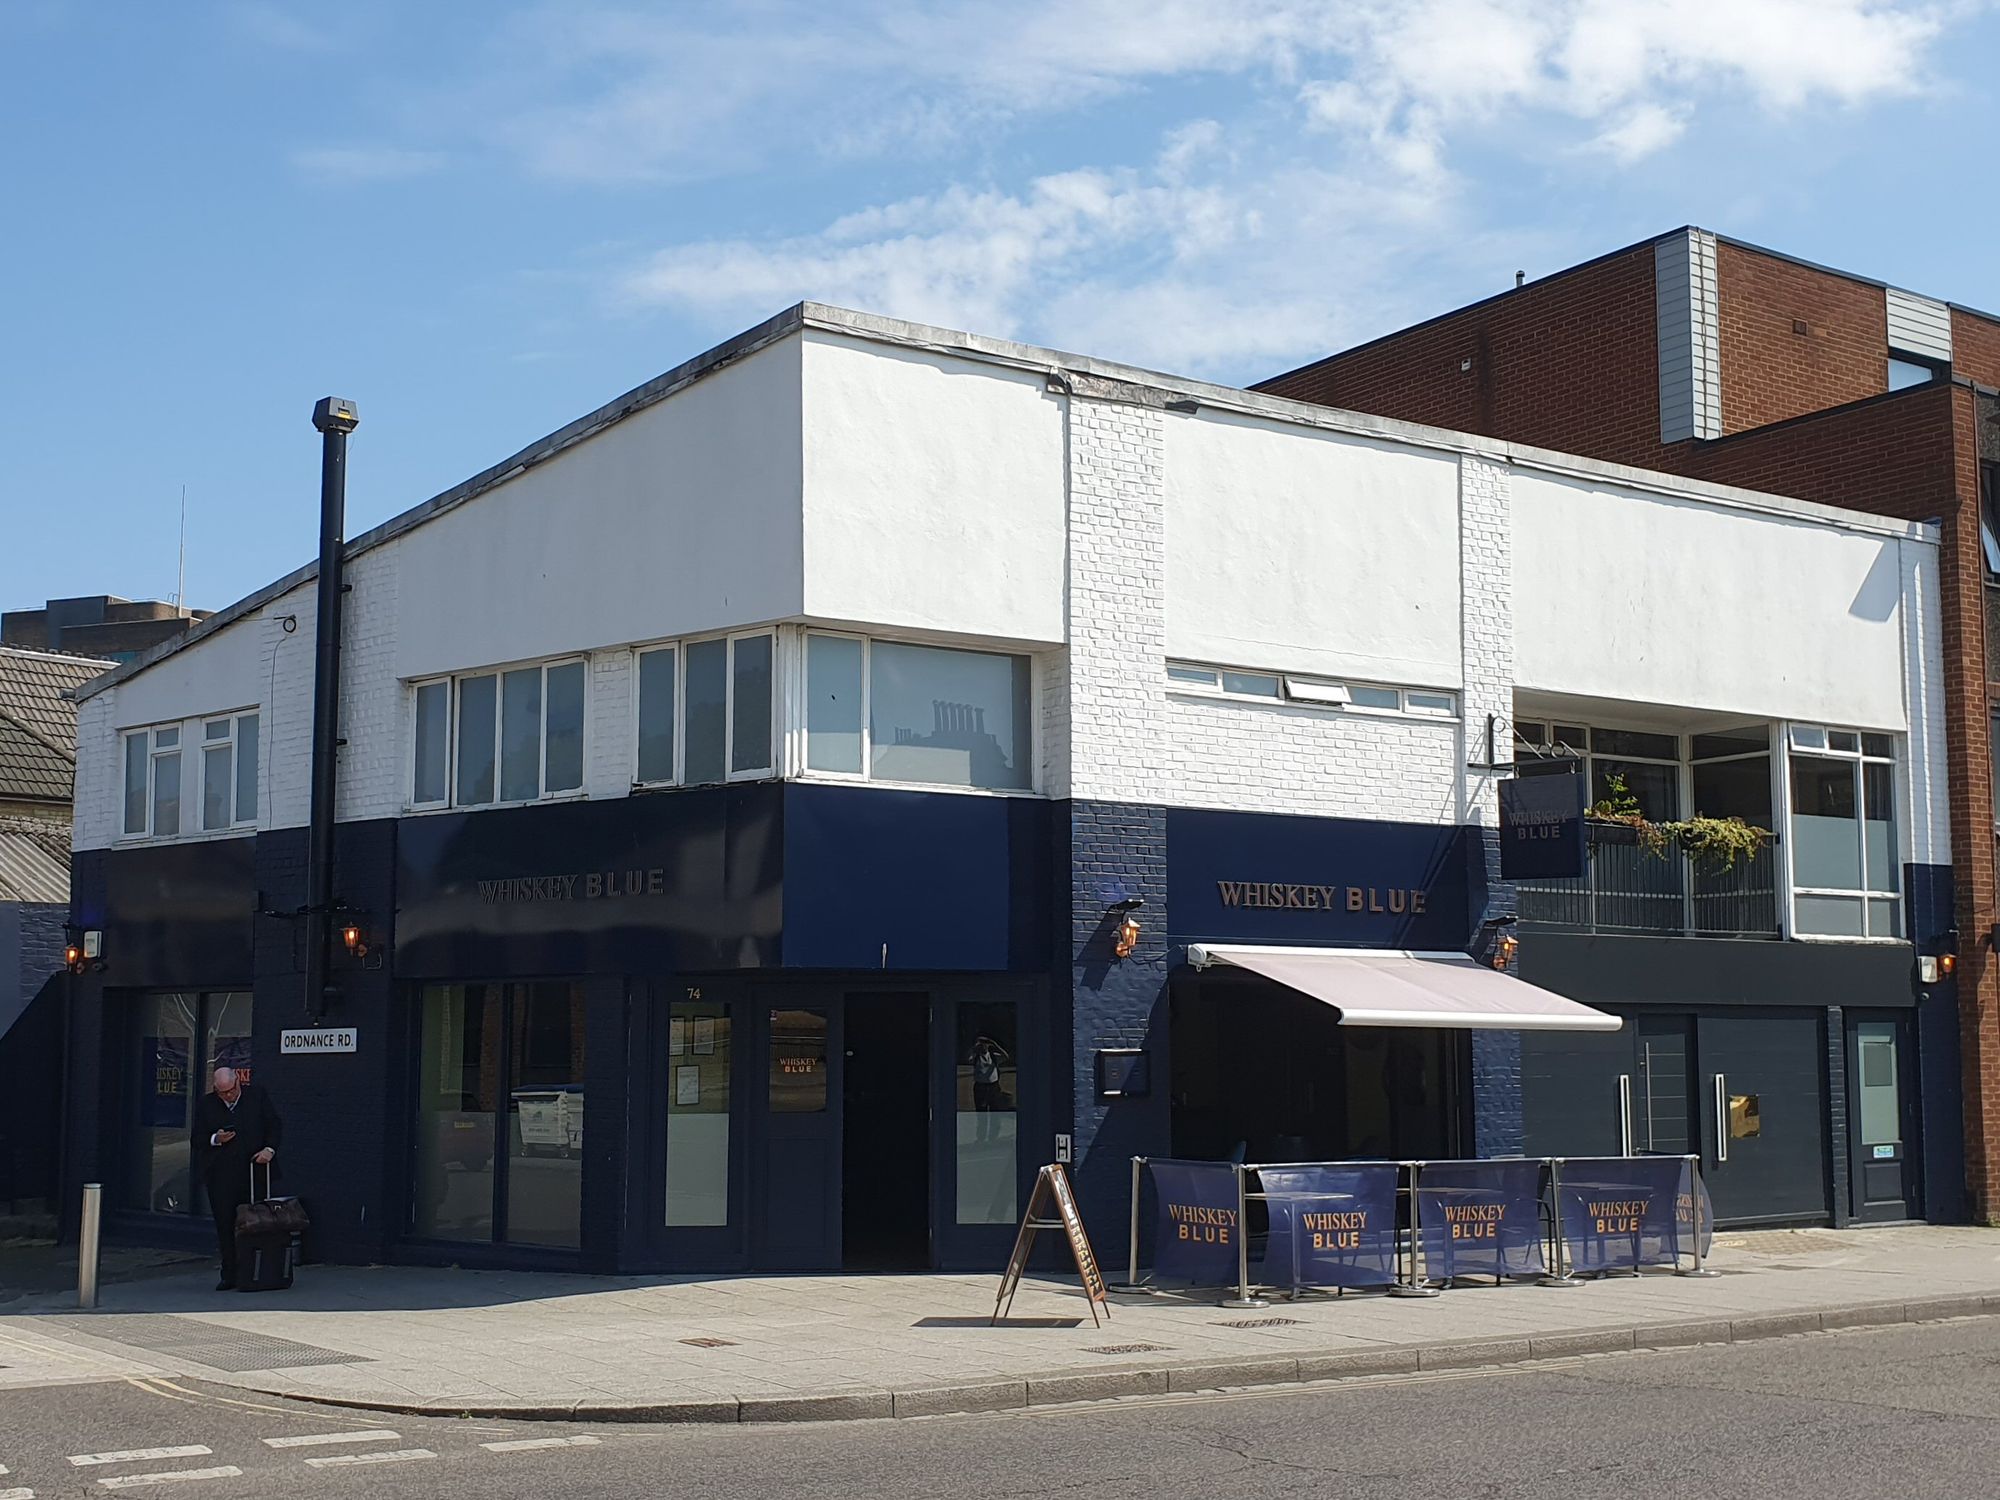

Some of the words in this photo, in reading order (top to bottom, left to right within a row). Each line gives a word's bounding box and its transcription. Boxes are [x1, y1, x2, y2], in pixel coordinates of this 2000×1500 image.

[1508, 810, 1568, 826] WHISKEY
[1518, 825, 1560, 840] BLUE
[477, 874, 578, 904] WHISKEY
[586, 868, 664, 897] BLUE
[1217, 880, 1336, 910] WHISKEY
[1345, 886, 1426, 913] BLUE
[687, 988, 701, 999] 74
[284, 1034, 335, 1048] ORDNANCE
[337, 1033, 354, 1047] RD.
[777, 1057, 818, 1066] WHISKEY
[784, 1065, 812, 1073] BLUE
[1168, 1204, 1238, 1226] WHISKEY
[1444, 1204, 1505, 1222] WHISKEY
[1588, 1200, 1649, 1217] WHISKEY
[1303, 1211, 1367, 1230] WHISKEY
[1596, 1217, 1638, 1233] BLUE
[1178, 1224, 1229, 1244] BLUE
[1452, 1222, 1496, 1238] BLUE
[1313, 1231, 1360, 1248] BLUE
